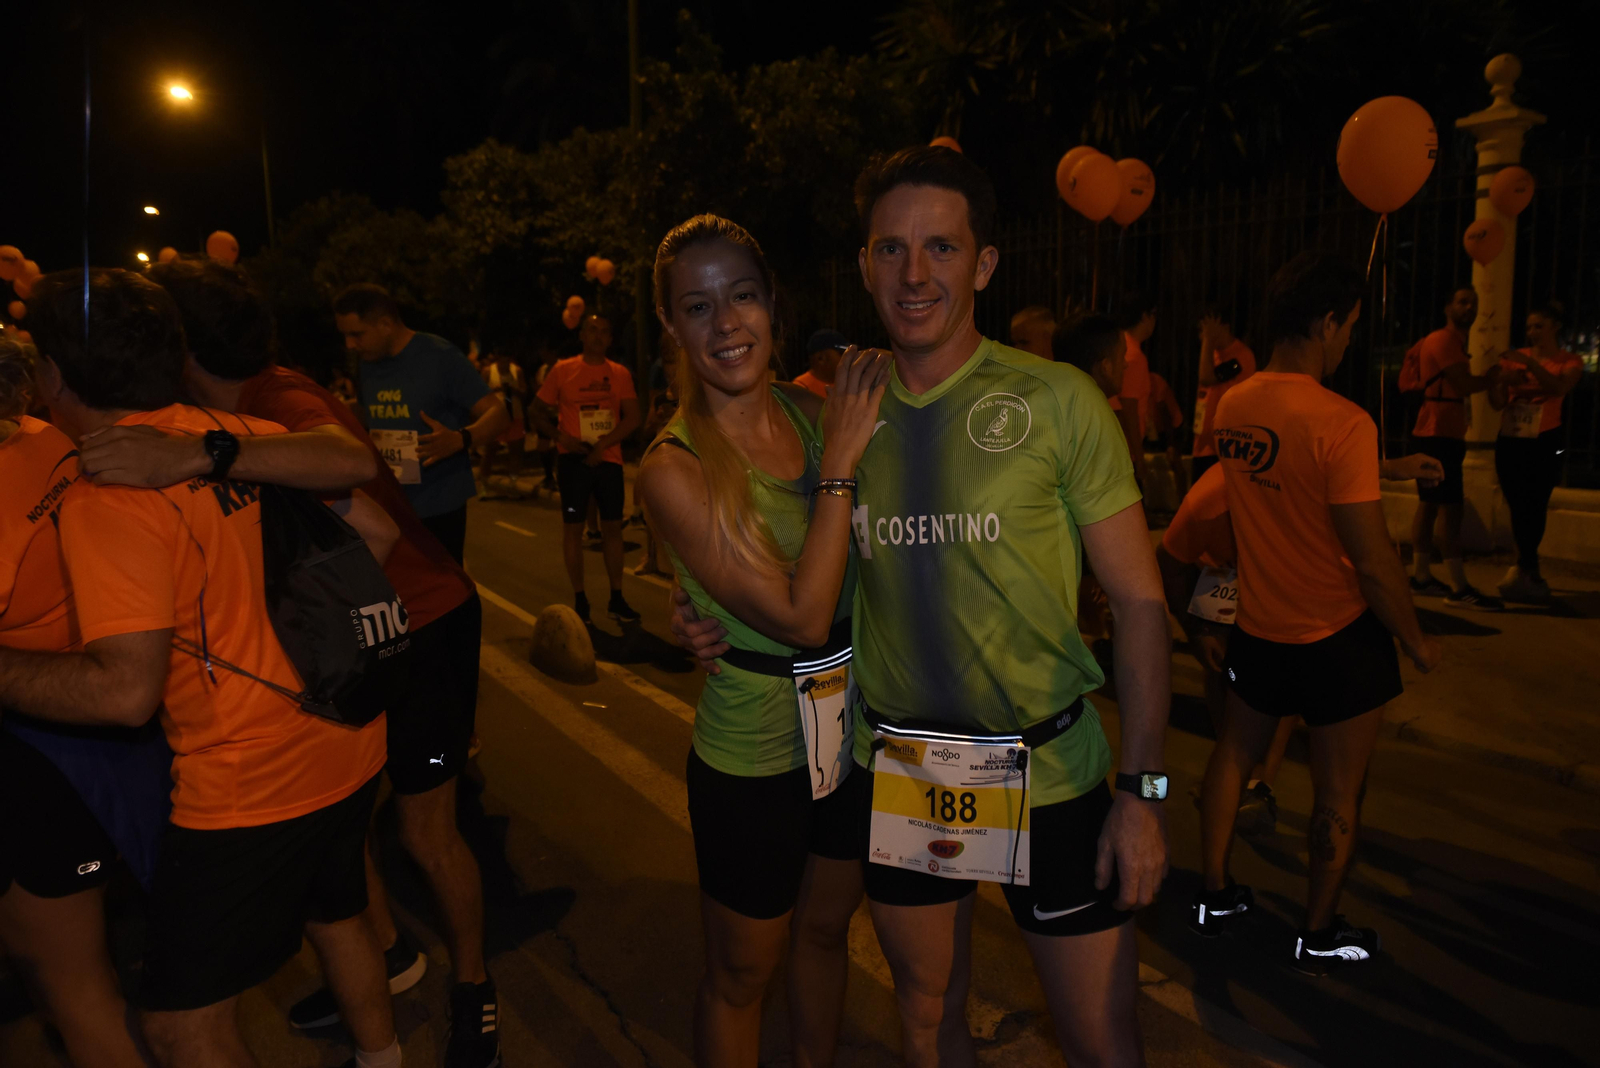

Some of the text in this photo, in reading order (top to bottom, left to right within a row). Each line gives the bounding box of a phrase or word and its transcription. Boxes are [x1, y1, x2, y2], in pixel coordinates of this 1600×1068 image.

[368, 404, 410, 419] TEAM
[26, 475, 72, 524] NOCTURNA
[876, 512, 1000, 546] COSENTINO
[350, 609, 366, 650] GRUPO
[926, 786, 977, 823] 188
[908, 819, 987, 836] NICOLÁS CADENAS JIMÉNEZ
